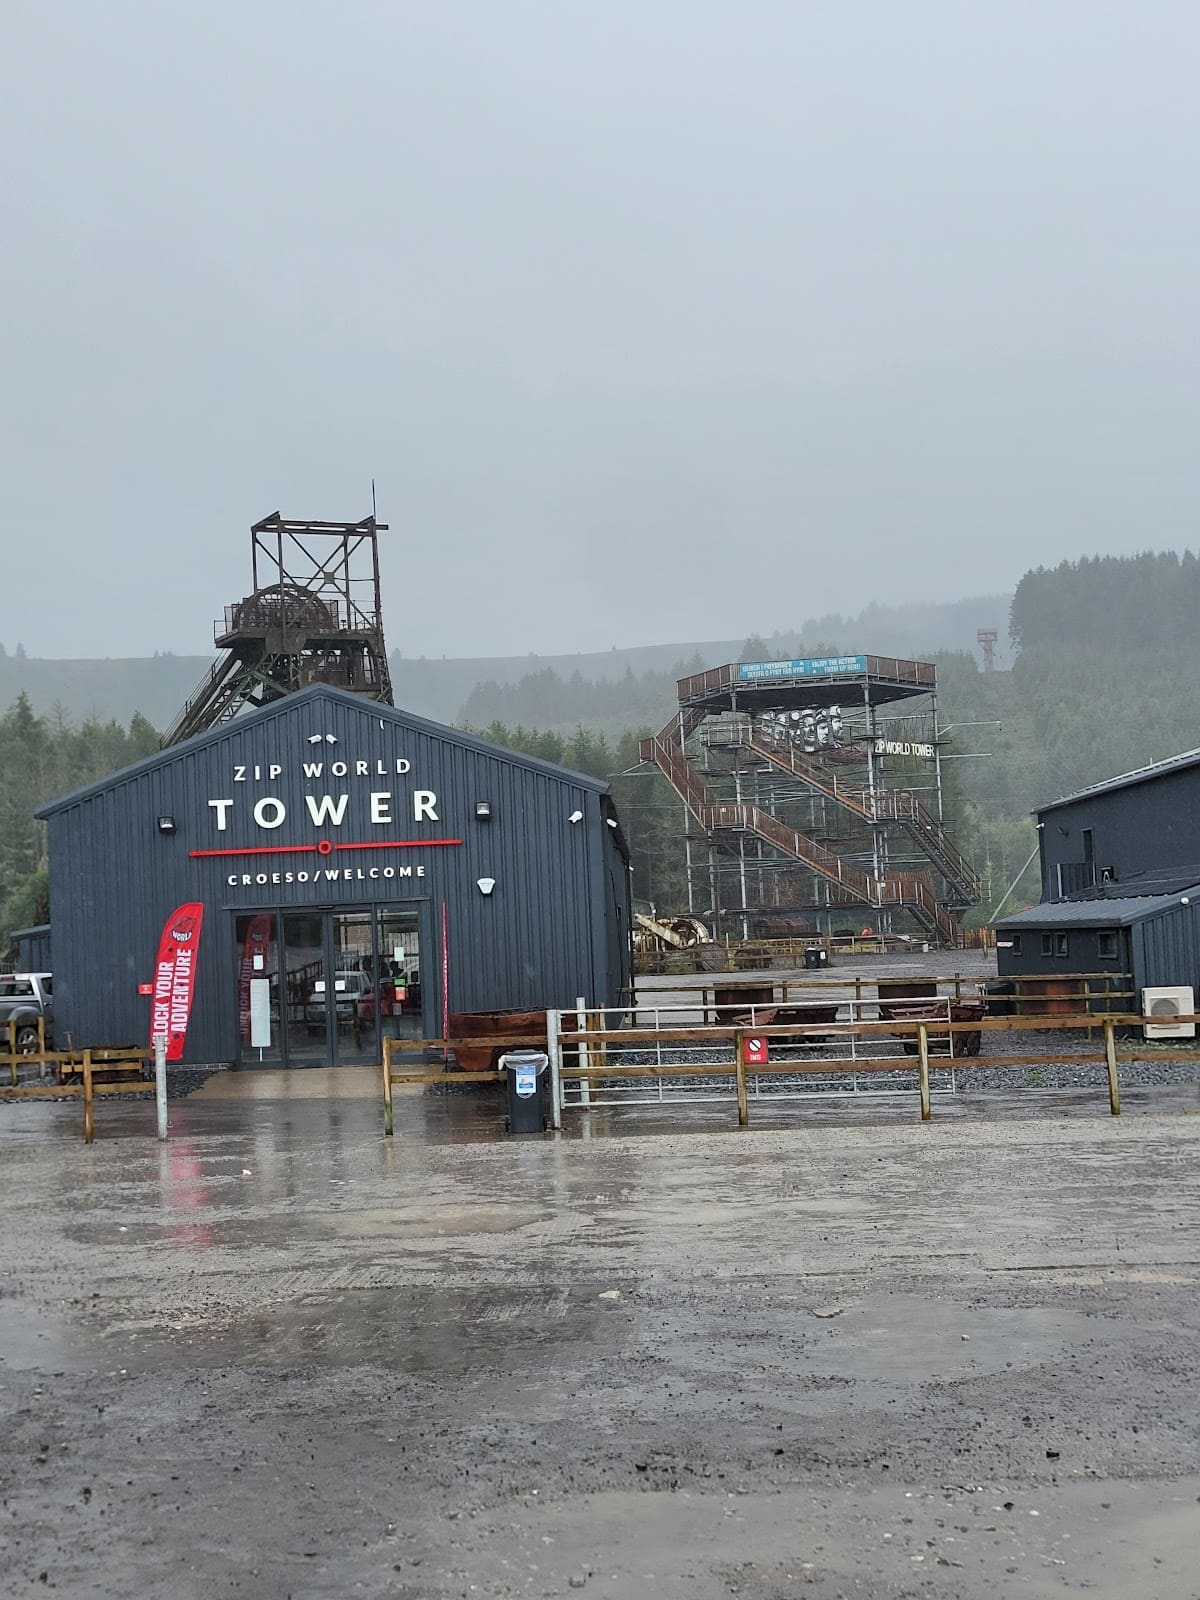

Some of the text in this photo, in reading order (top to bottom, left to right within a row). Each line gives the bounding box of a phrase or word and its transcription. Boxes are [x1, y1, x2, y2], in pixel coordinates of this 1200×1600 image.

[885, 740, 911, 755] WORLD
[911, 743, 935, 757] TOWER
[233, 758, 411, 782] ZIP WORLD
[208, 790, 440, 831] TOWER
[227, 865, 426, 887] CROESO/WELCOME
[156, 961, 175, 999] YOUR
[171, 948, 192, 1033] ADVENTURE
